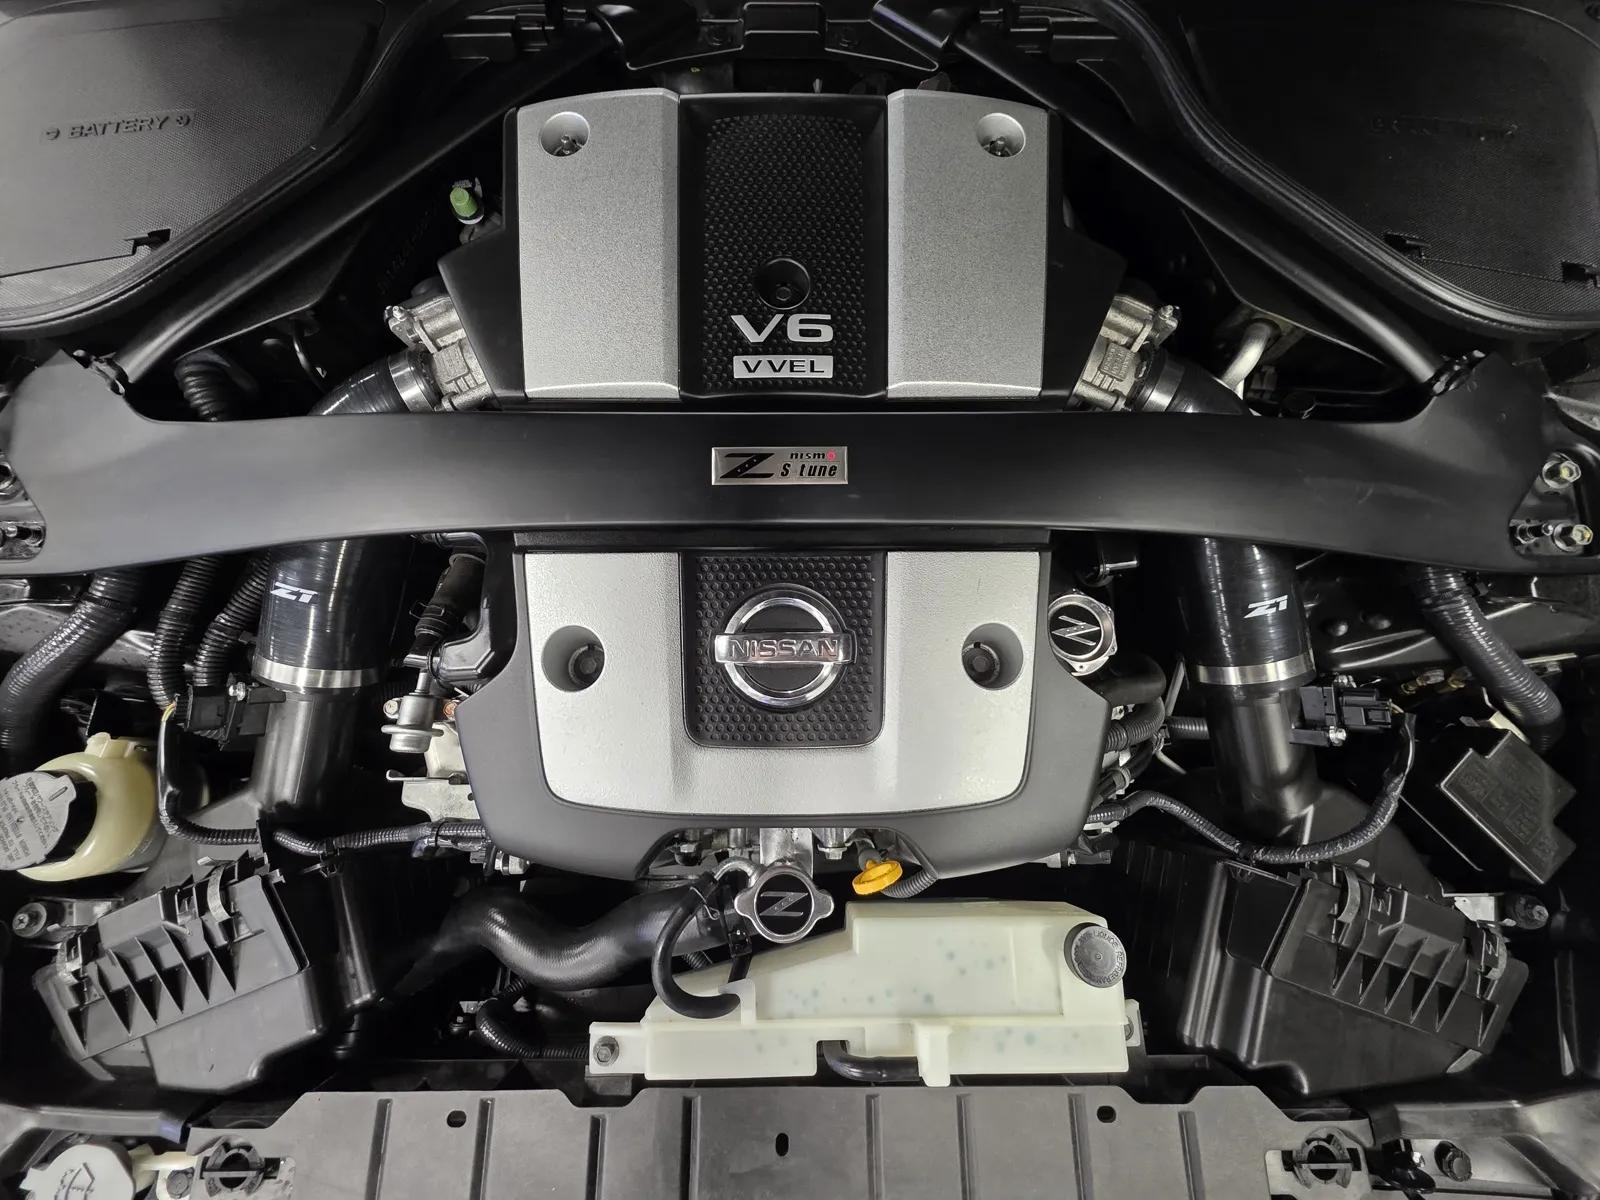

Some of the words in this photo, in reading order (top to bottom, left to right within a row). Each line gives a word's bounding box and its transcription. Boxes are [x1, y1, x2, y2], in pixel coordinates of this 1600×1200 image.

[69, 115, 170, 139] BATTERY
[731, 314, 834, 342] V6
[742, 360, 825, 373] VVEL
[799, 463, 838, 477] tune
[1243, 595, 1289, 619] Z1
[728, 639, 839, 658] NISSAN
